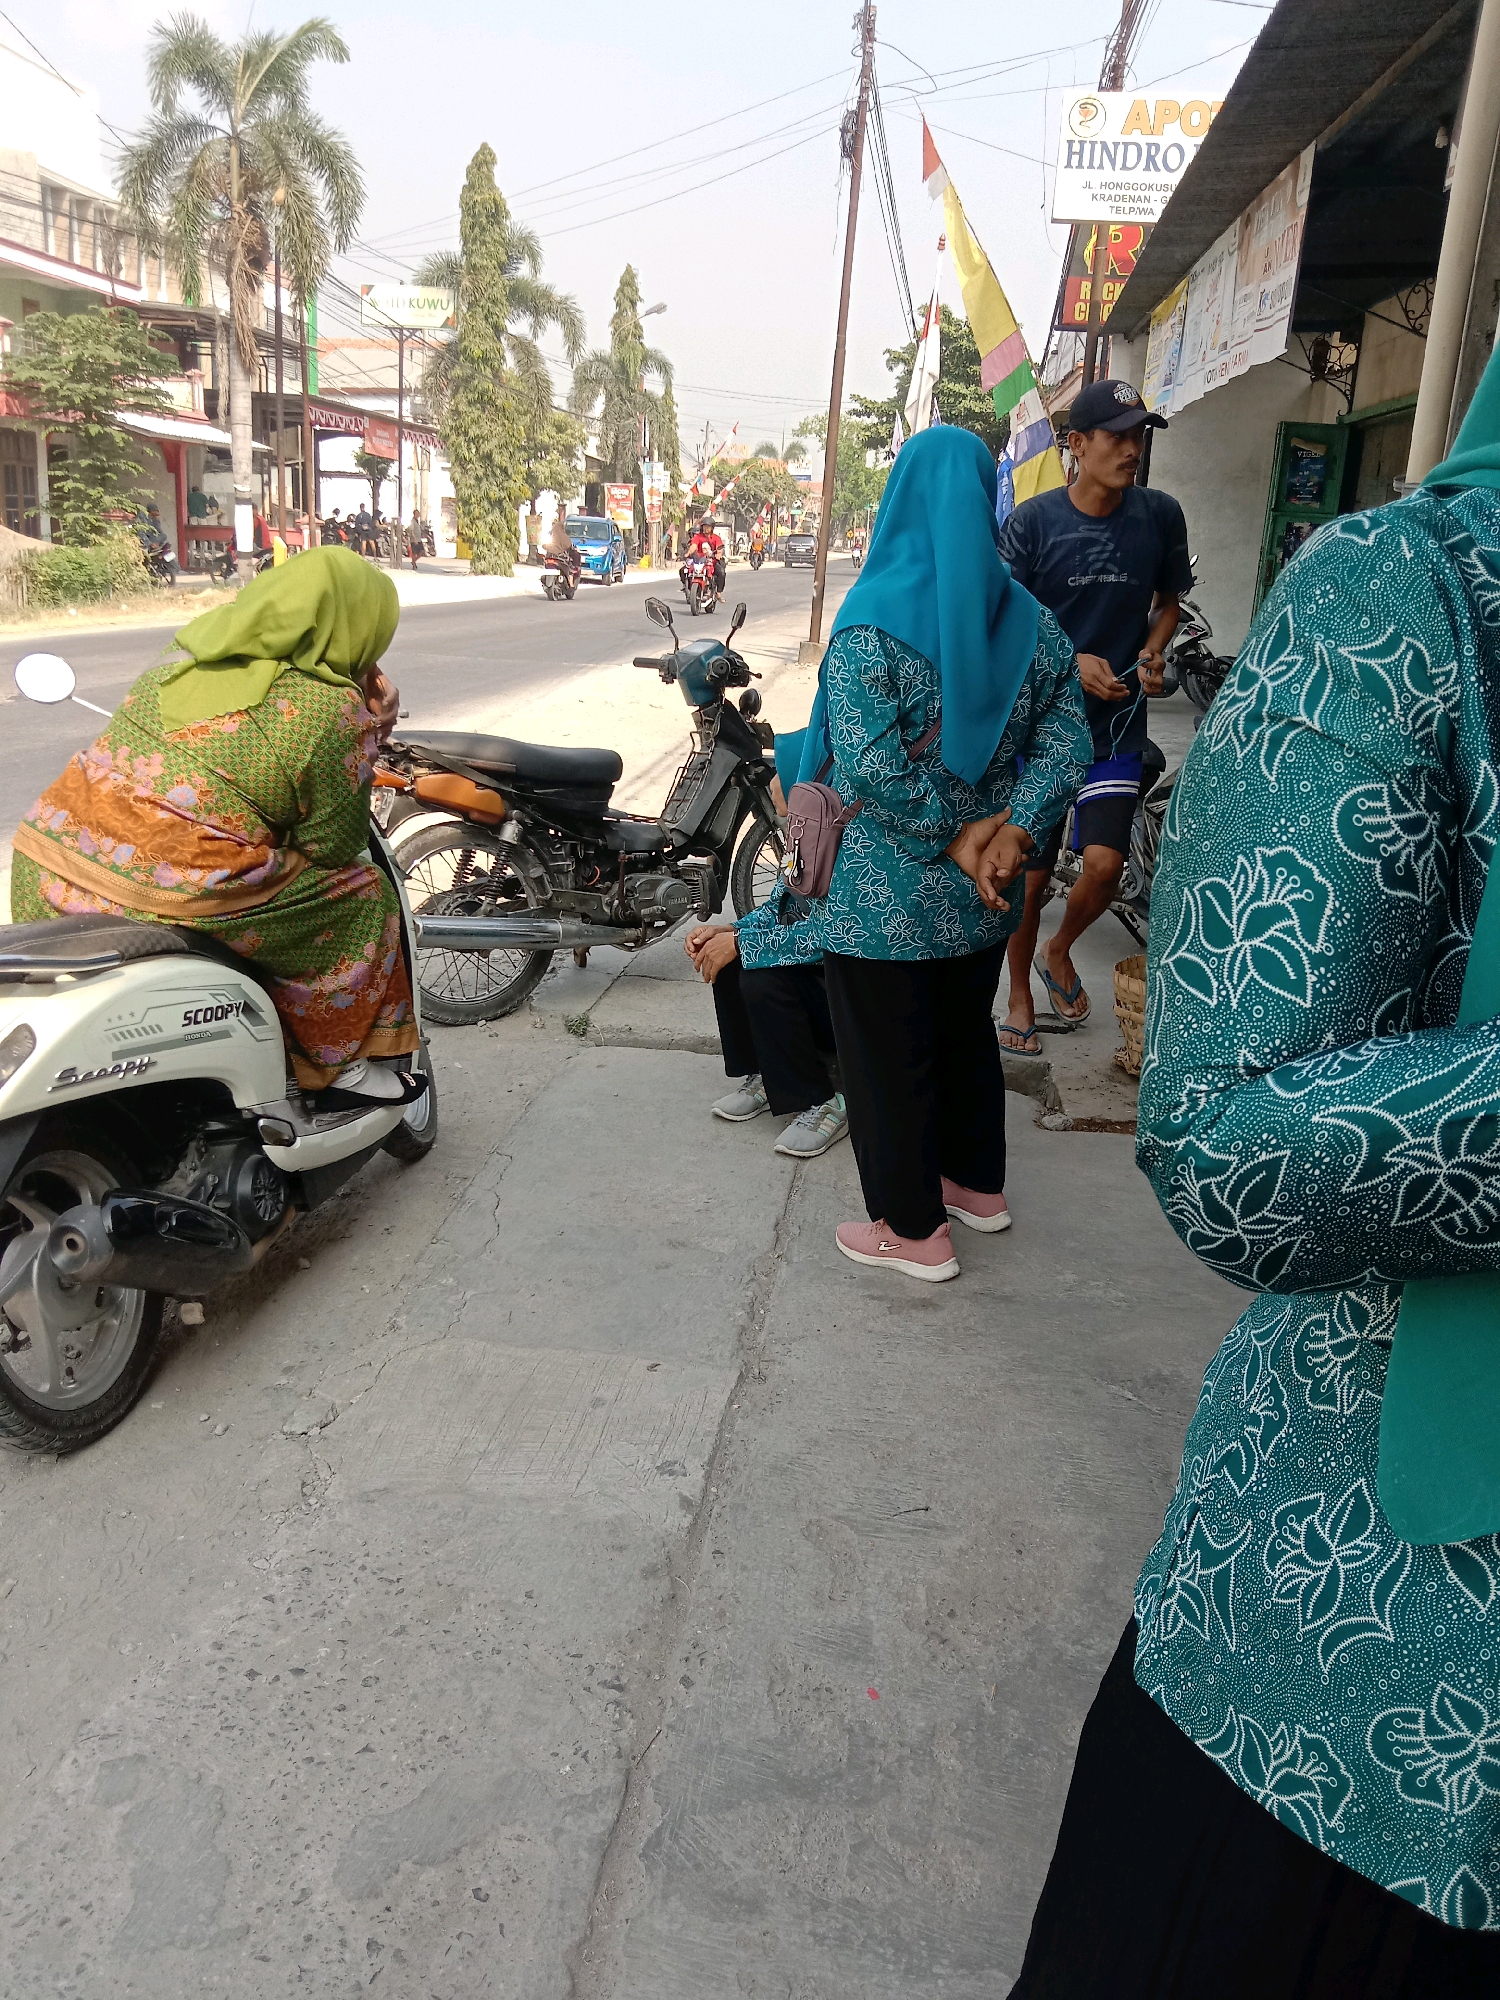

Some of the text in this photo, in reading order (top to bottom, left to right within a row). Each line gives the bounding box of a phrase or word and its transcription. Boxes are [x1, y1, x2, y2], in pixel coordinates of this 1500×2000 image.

[1064, 139, 1186, 174] HINDRO
[1082, 180, 1097, 190] JL.
[1091, 193, 1151, 204] KRADENAN
[408, 297, 450, 311] KUWU
[181, 1001, 243, 1028] SCOOPY
[184, 1031, 213, 1041] HONDA
[47, 1056, 157, 1093] Scoopy
